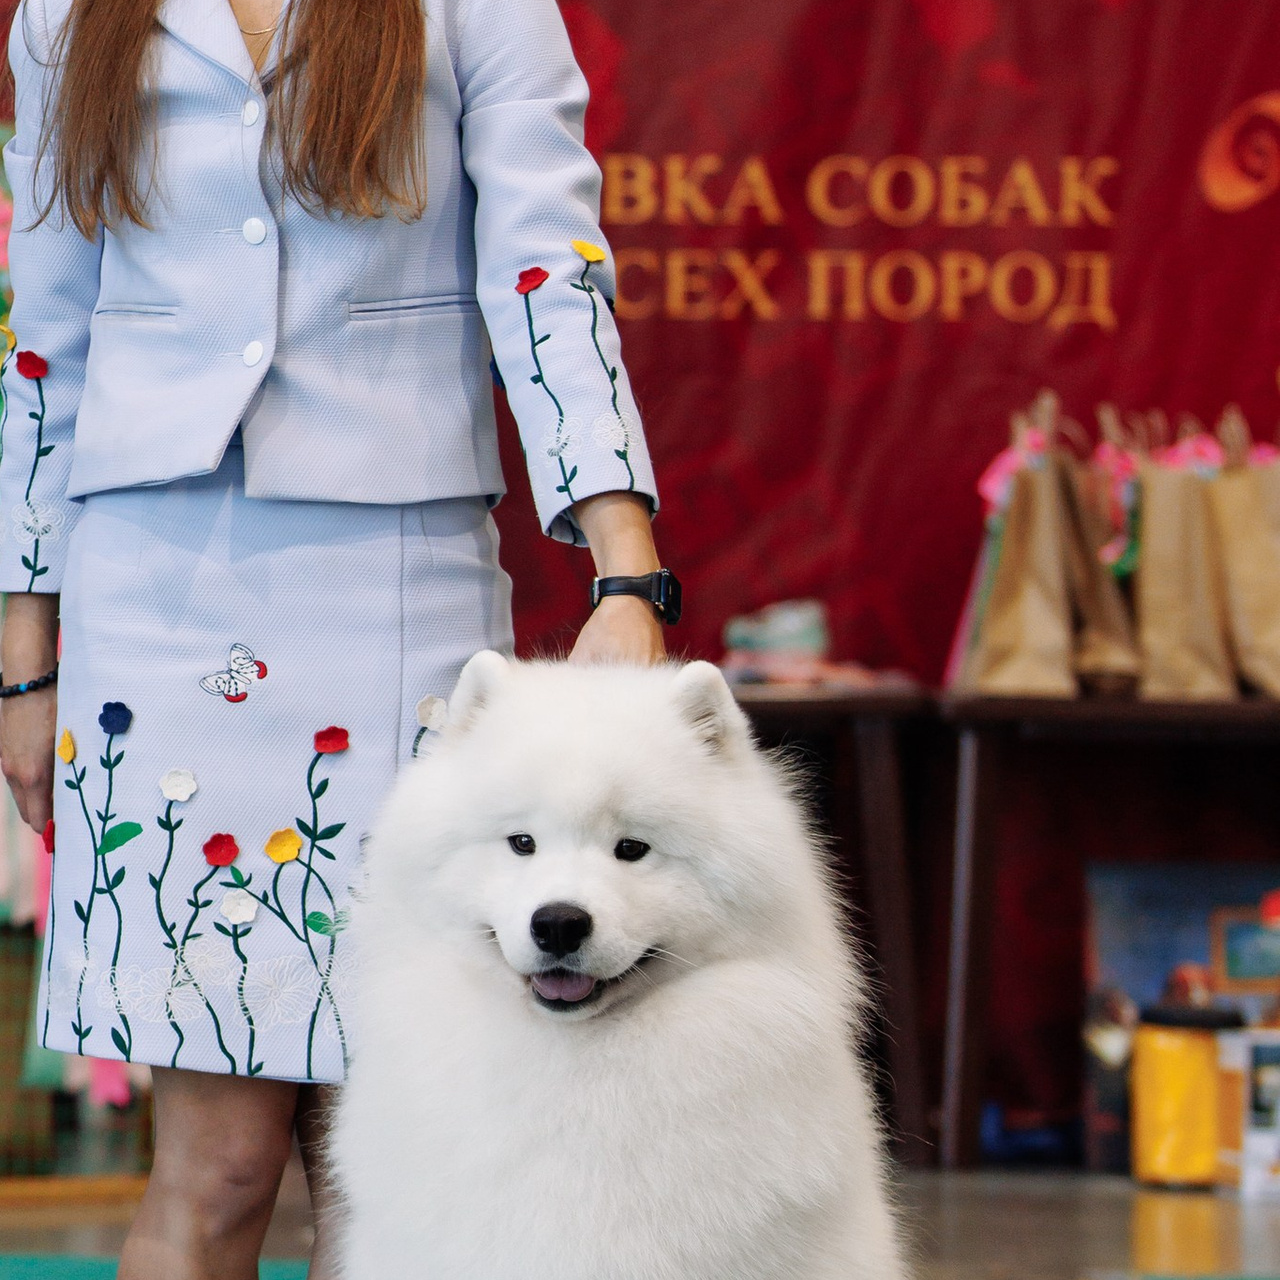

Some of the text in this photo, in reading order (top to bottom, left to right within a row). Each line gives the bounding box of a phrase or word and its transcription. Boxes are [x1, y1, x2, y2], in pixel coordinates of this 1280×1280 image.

[601, 153, 1120, 229] ВКА СОБАК
[806, 249, 1119, 333] ПОРОД
